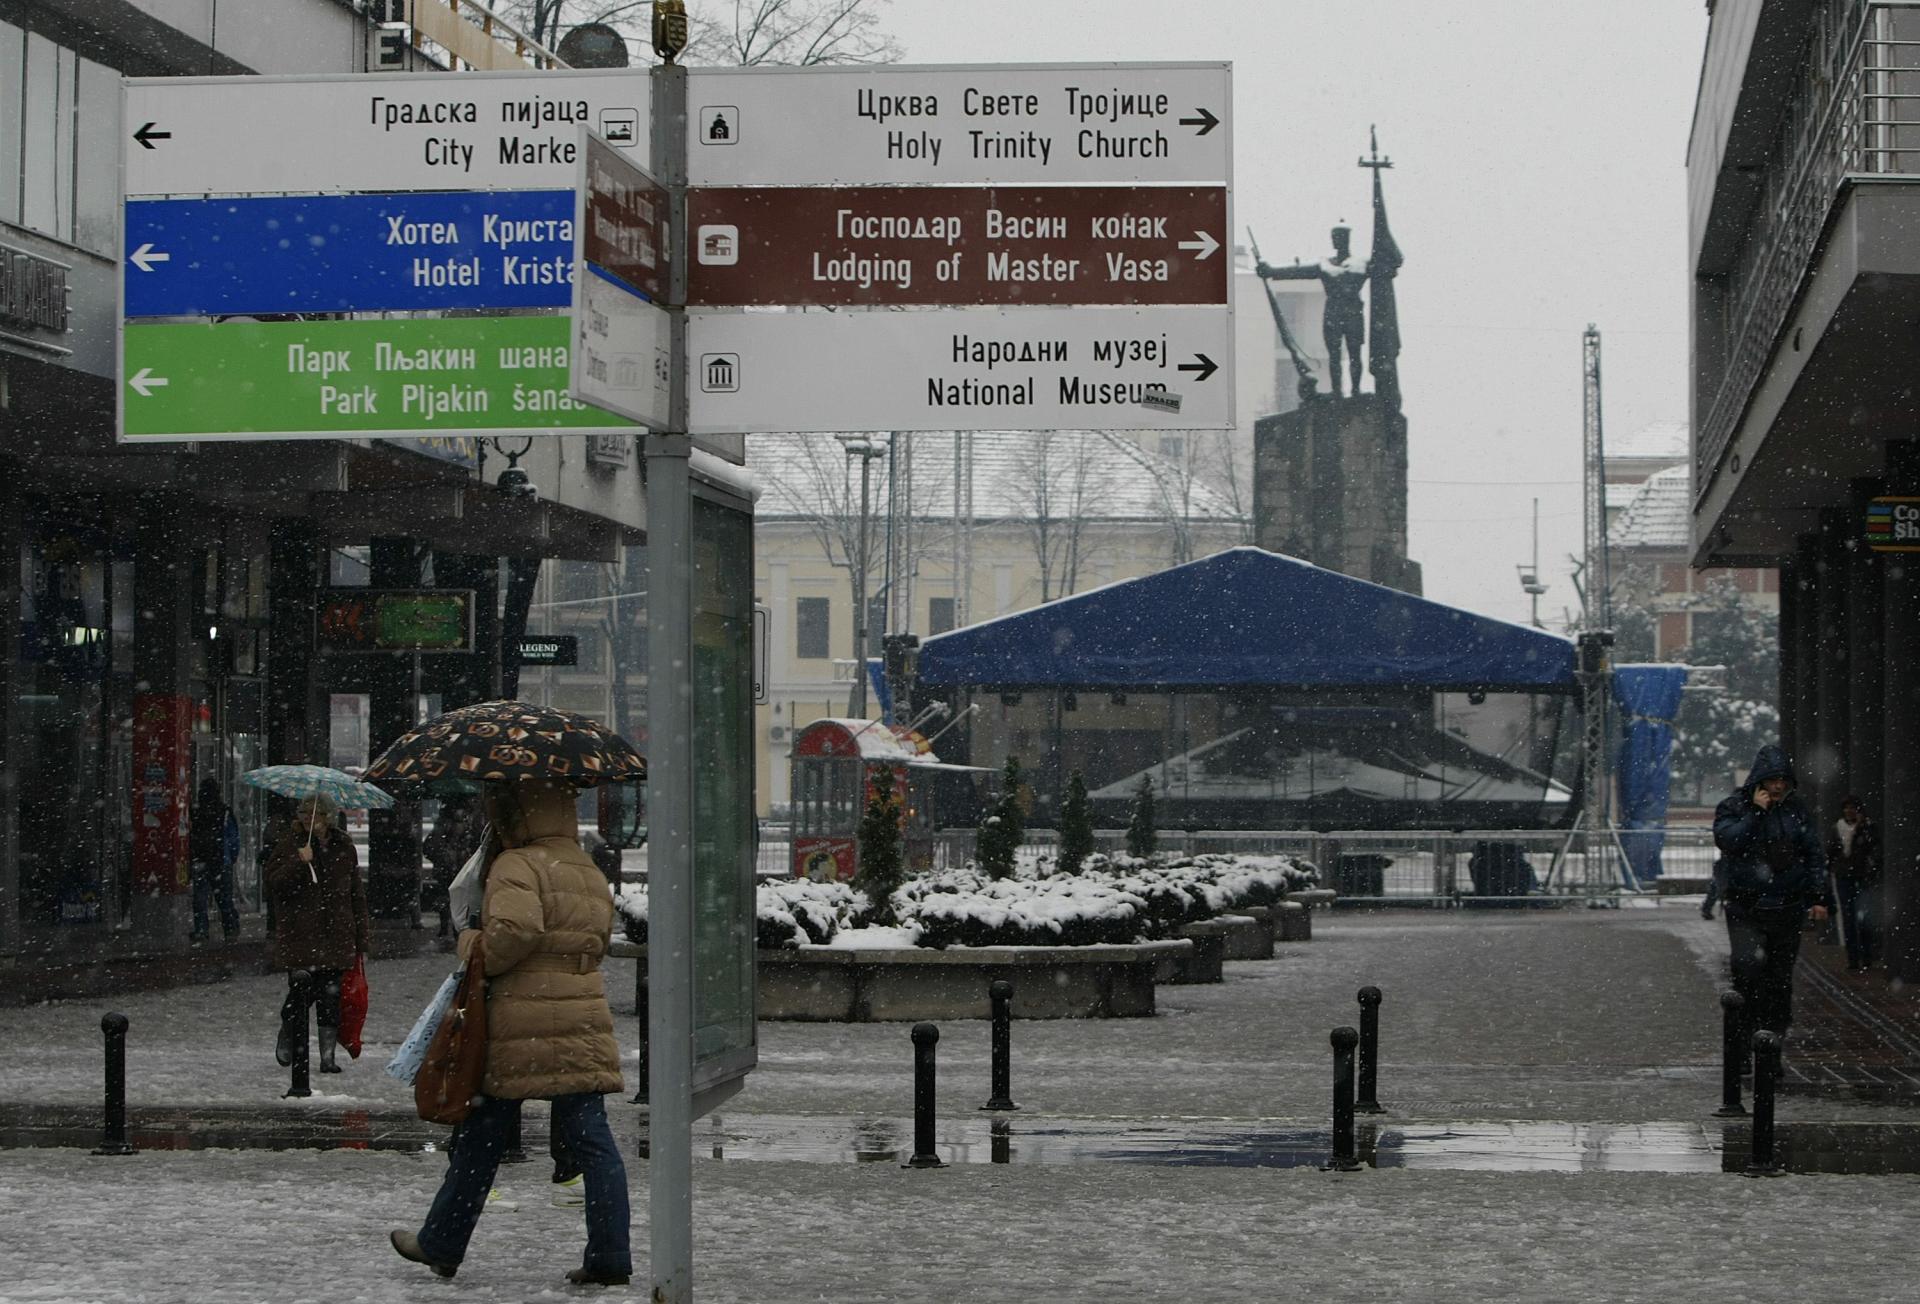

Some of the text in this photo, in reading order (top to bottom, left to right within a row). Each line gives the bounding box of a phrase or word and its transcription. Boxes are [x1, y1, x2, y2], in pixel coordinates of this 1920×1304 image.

[372, 95, 588, 131] Градска пијаца
[858, 88, 1167, 124] Црква Свете Тројице
[426, 137, 575, 172] City Marke
[888, 130, 1167, 166] Holy Trinity Church
[388, 216, 458, 244] Хотел
[484, 215, 573, 249] Криста
[838, 210, 1167, 245] Господар Васин конак
[414, 256, 575, 286] Hotel Krista
[814, 253, 1167, 288] Lodging of Master Vasa
[289, 344, 350, 379] Парк
[376, 343, 475, 370] Пљакин
[500, 347, 568, 369] шана
[954, 334, 1167, 369] Народни музеј
[321, 385, 377, 414] Park
[403, 384, 487, 419] Pljakin
[929, 377, 1033, 405] National
[520, 644, 558, 652] LEGEND
